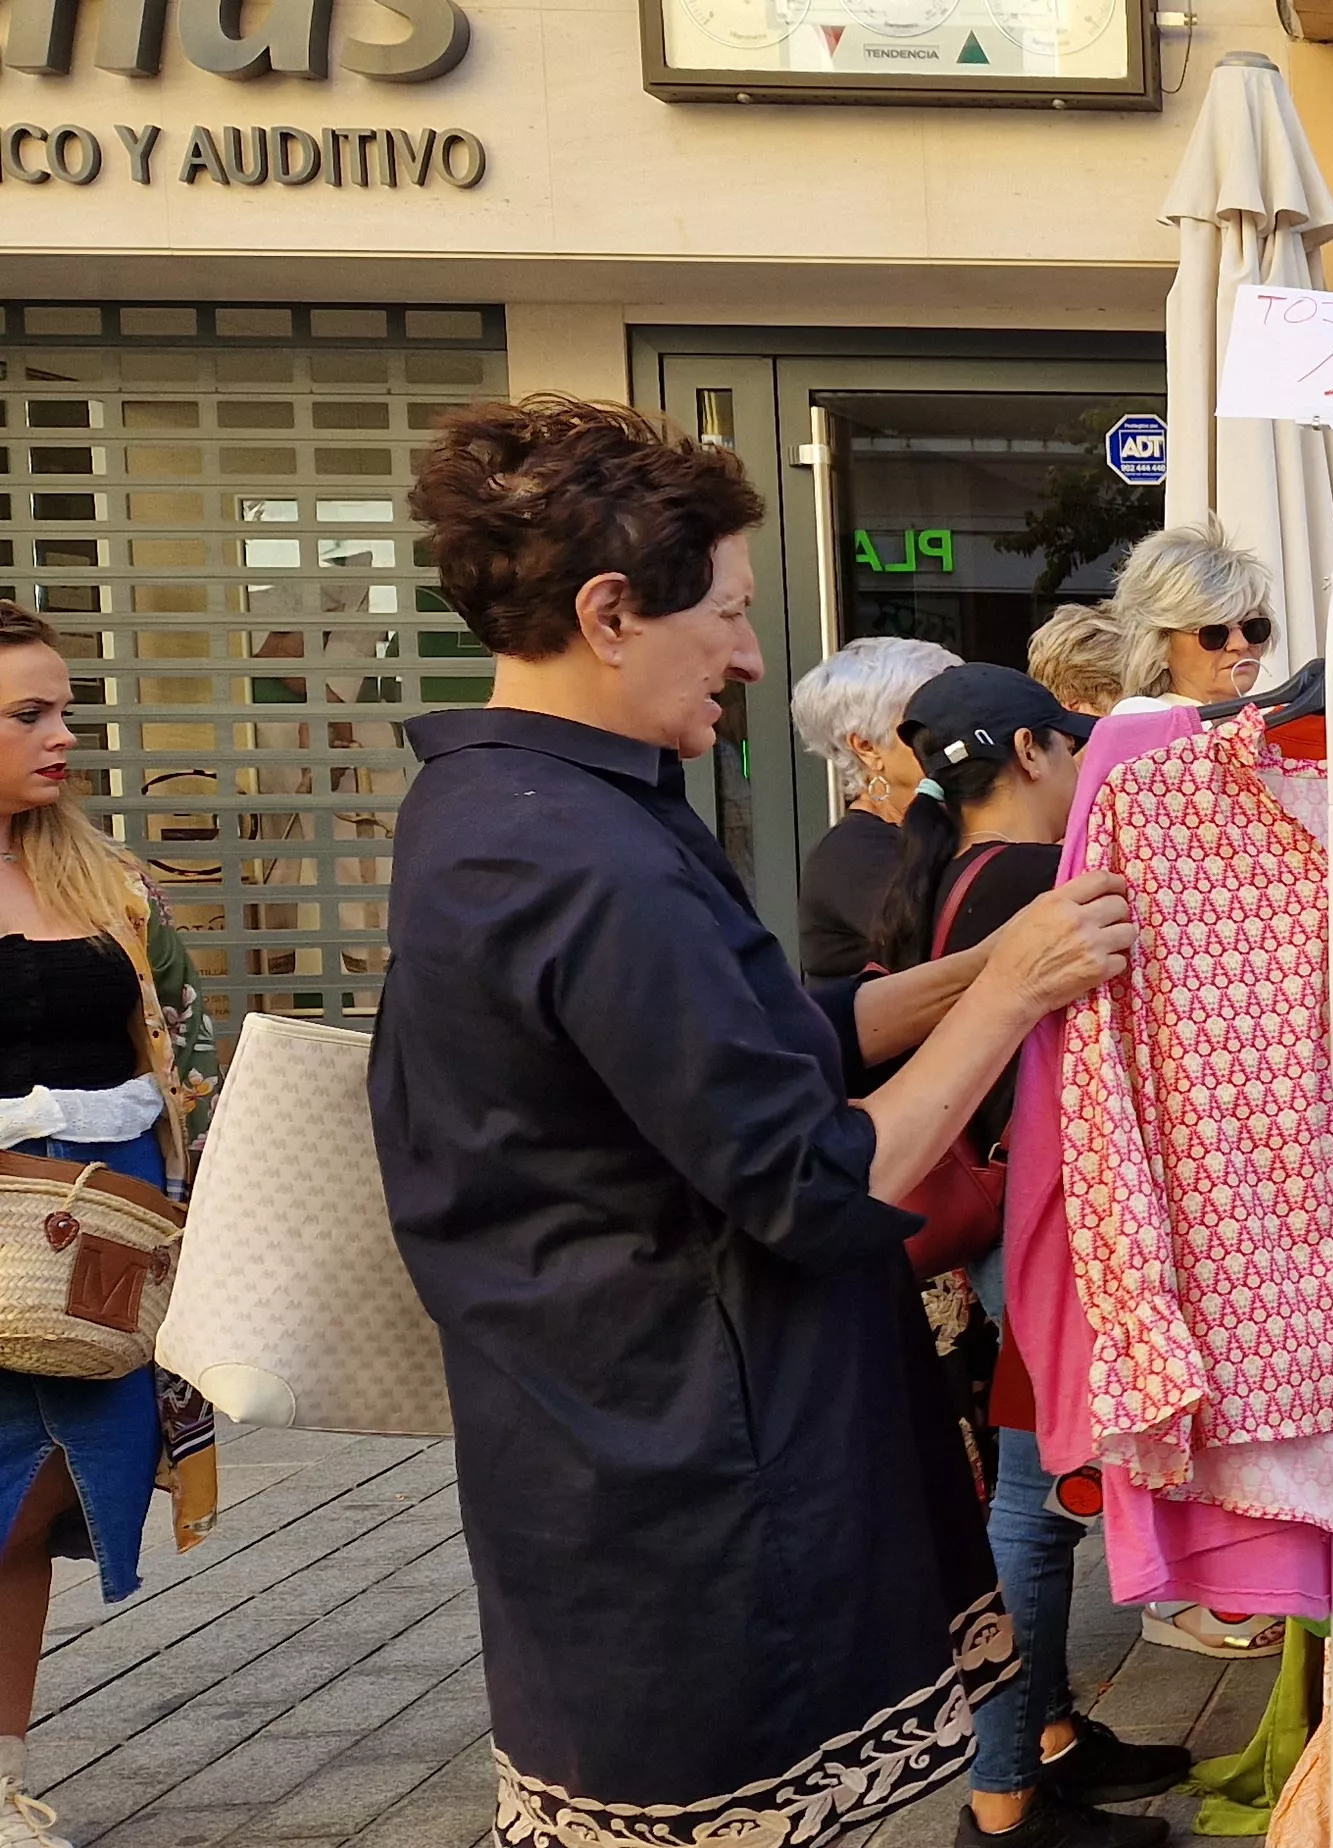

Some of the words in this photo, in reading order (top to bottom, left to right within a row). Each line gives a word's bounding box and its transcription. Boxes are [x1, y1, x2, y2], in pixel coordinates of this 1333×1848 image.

[865, 49, 940, 60] TENDENCIA
[0, 122, 102, 186] CO
[114, 124, 161, 185] Y
[178, 124, 487, 189] AUDITIVO
[1121, 434, 1164, 458] ADT
